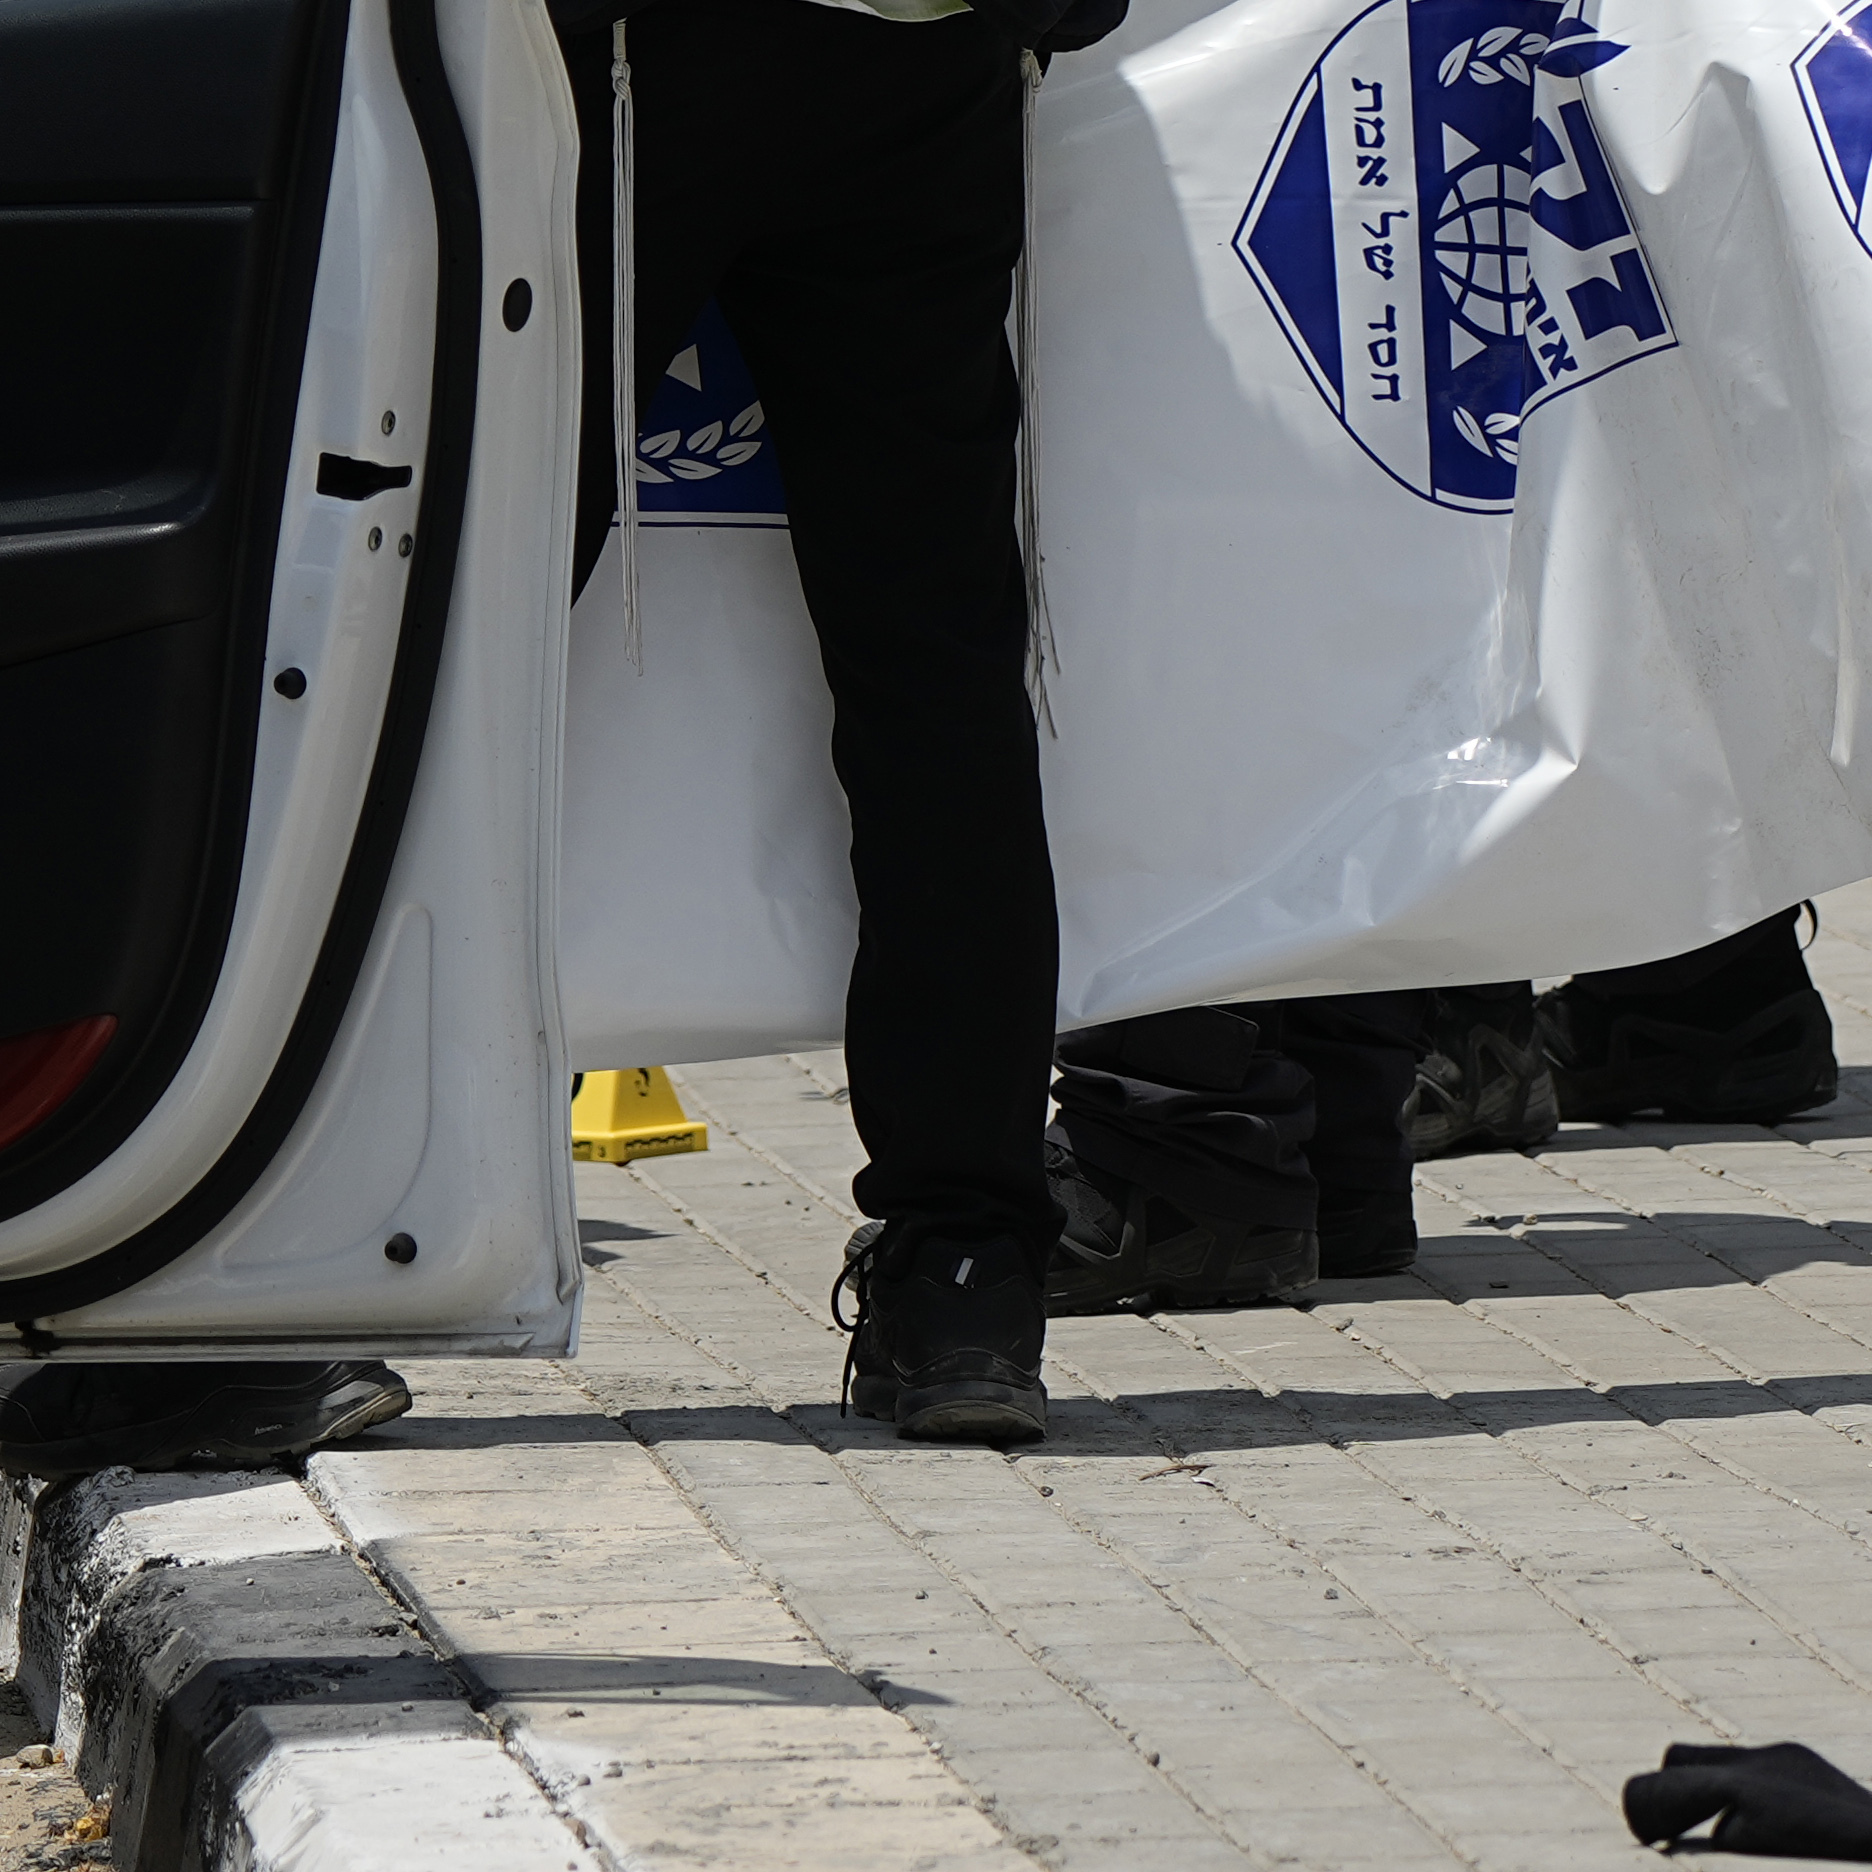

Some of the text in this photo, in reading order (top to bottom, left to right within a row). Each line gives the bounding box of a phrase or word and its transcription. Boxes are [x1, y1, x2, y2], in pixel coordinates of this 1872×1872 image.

[1351, 77, 1410, 404] חסד של אמת
